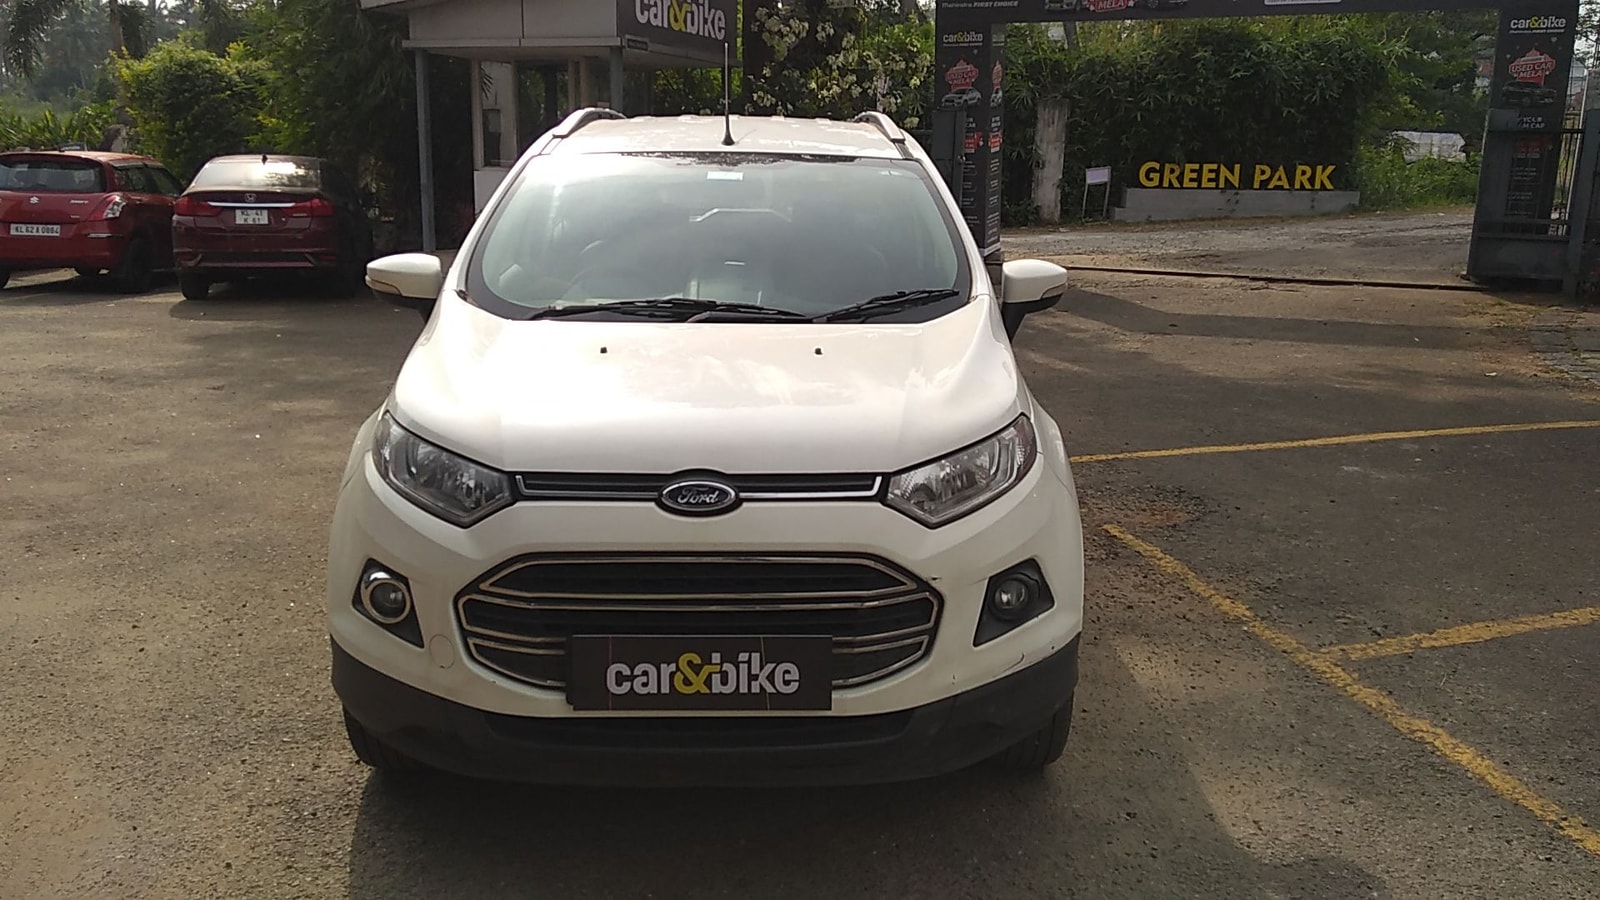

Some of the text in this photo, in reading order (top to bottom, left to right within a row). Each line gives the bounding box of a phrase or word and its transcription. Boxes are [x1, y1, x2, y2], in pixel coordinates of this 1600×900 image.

[635, 0, 726, 40] car&bike
[1510, 16, 1567, 28] car&bike
[942, 32, 983, 42] car&bike
[1138, 161, 1337, 190] GREEN PARK
[677, 486, 720, 504] Ford
[606, 652, 800, 694] car&bike
